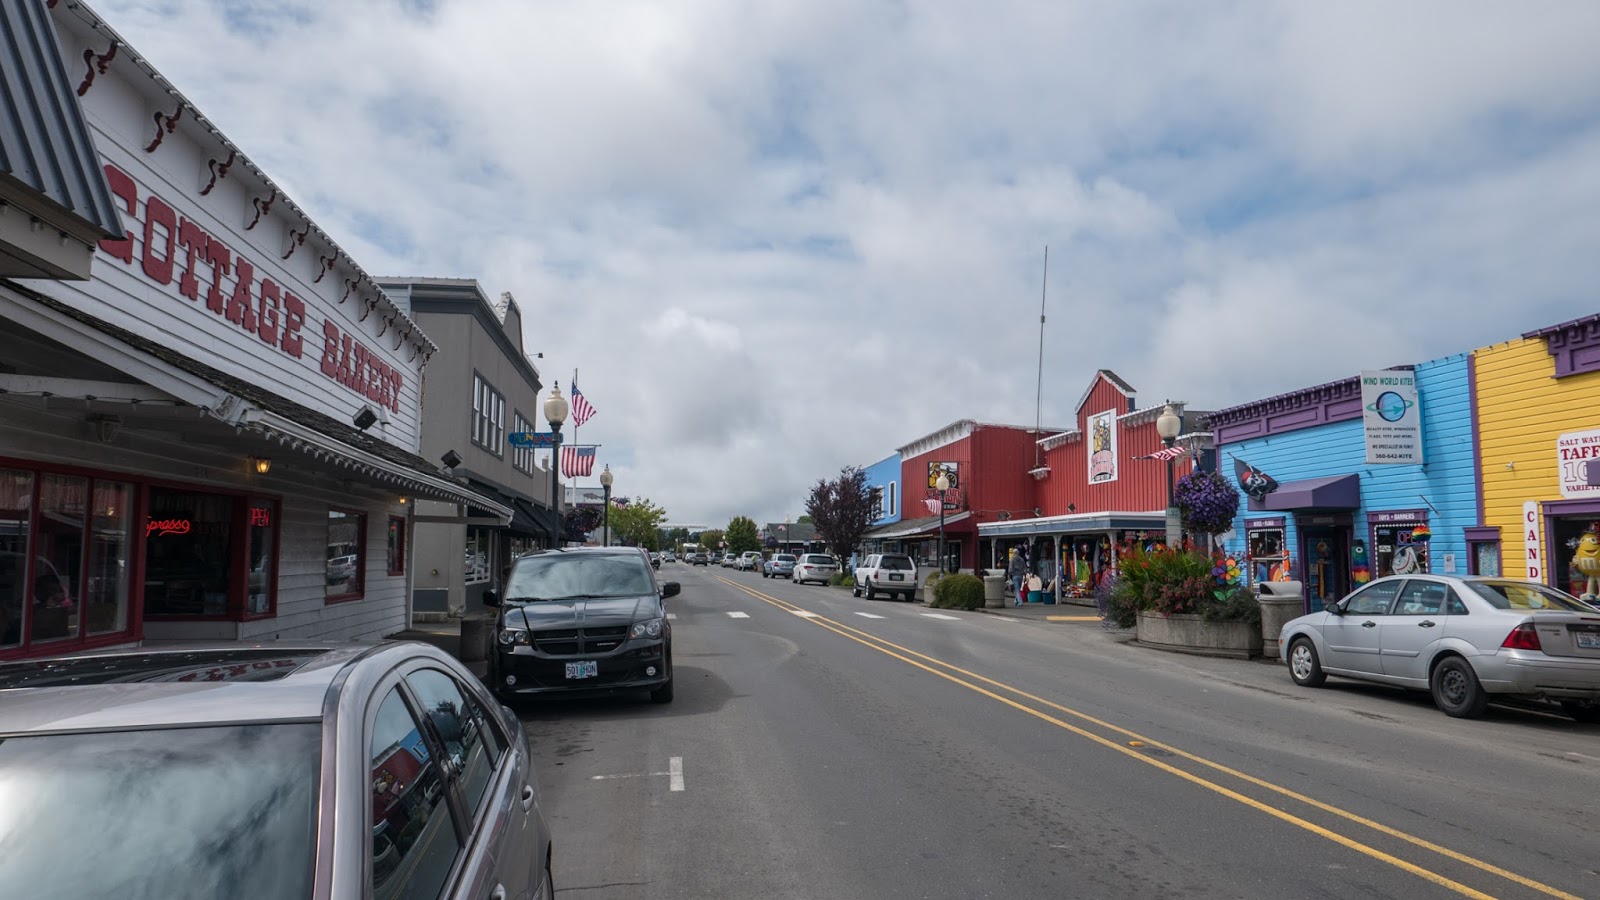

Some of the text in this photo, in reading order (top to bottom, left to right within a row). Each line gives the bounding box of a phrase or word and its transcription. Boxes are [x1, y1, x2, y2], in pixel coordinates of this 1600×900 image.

[97, 164, 404, 414] COTTAGE BAKERY
[1363, 377, 1413, 386] WIND WORLD KITES
[1560, 438, 1579, 447] SALT
